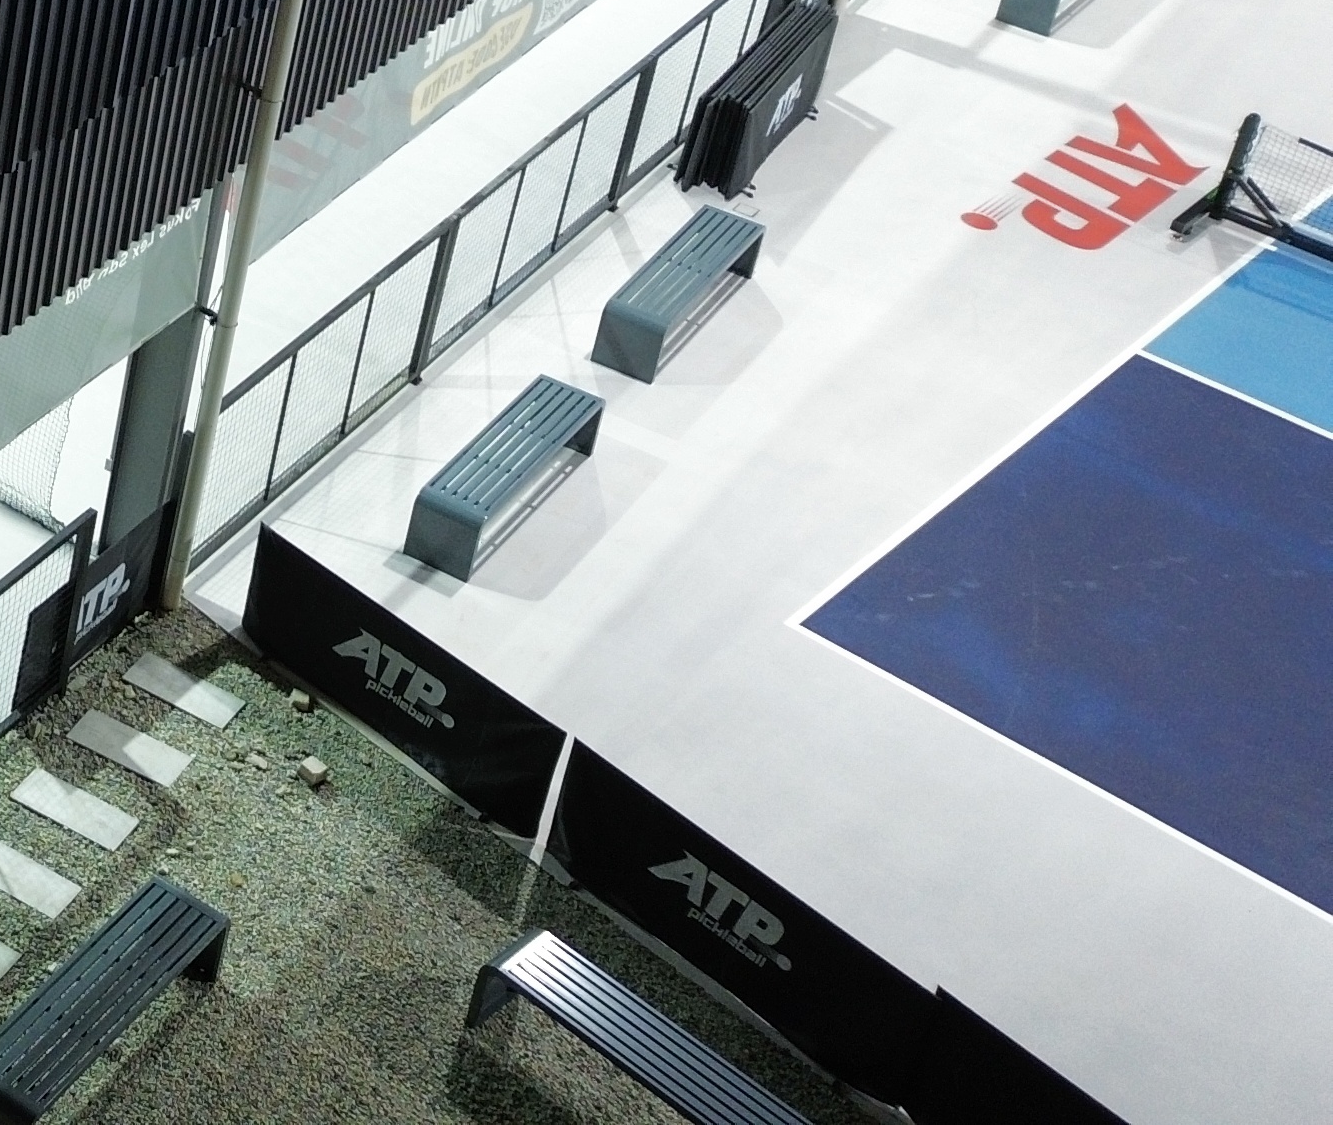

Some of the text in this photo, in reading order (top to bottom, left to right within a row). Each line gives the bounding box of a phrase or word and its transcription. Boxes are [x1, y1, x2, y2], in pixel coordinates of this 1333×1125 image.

[1013, 104, 1209, 250] ATP
[332, 627, 447, 707] ATP
[365, 679, 433, 728] pickleball
[647, 849, 785, 946] ATP
[687, 908, 767, 968] pickleball
